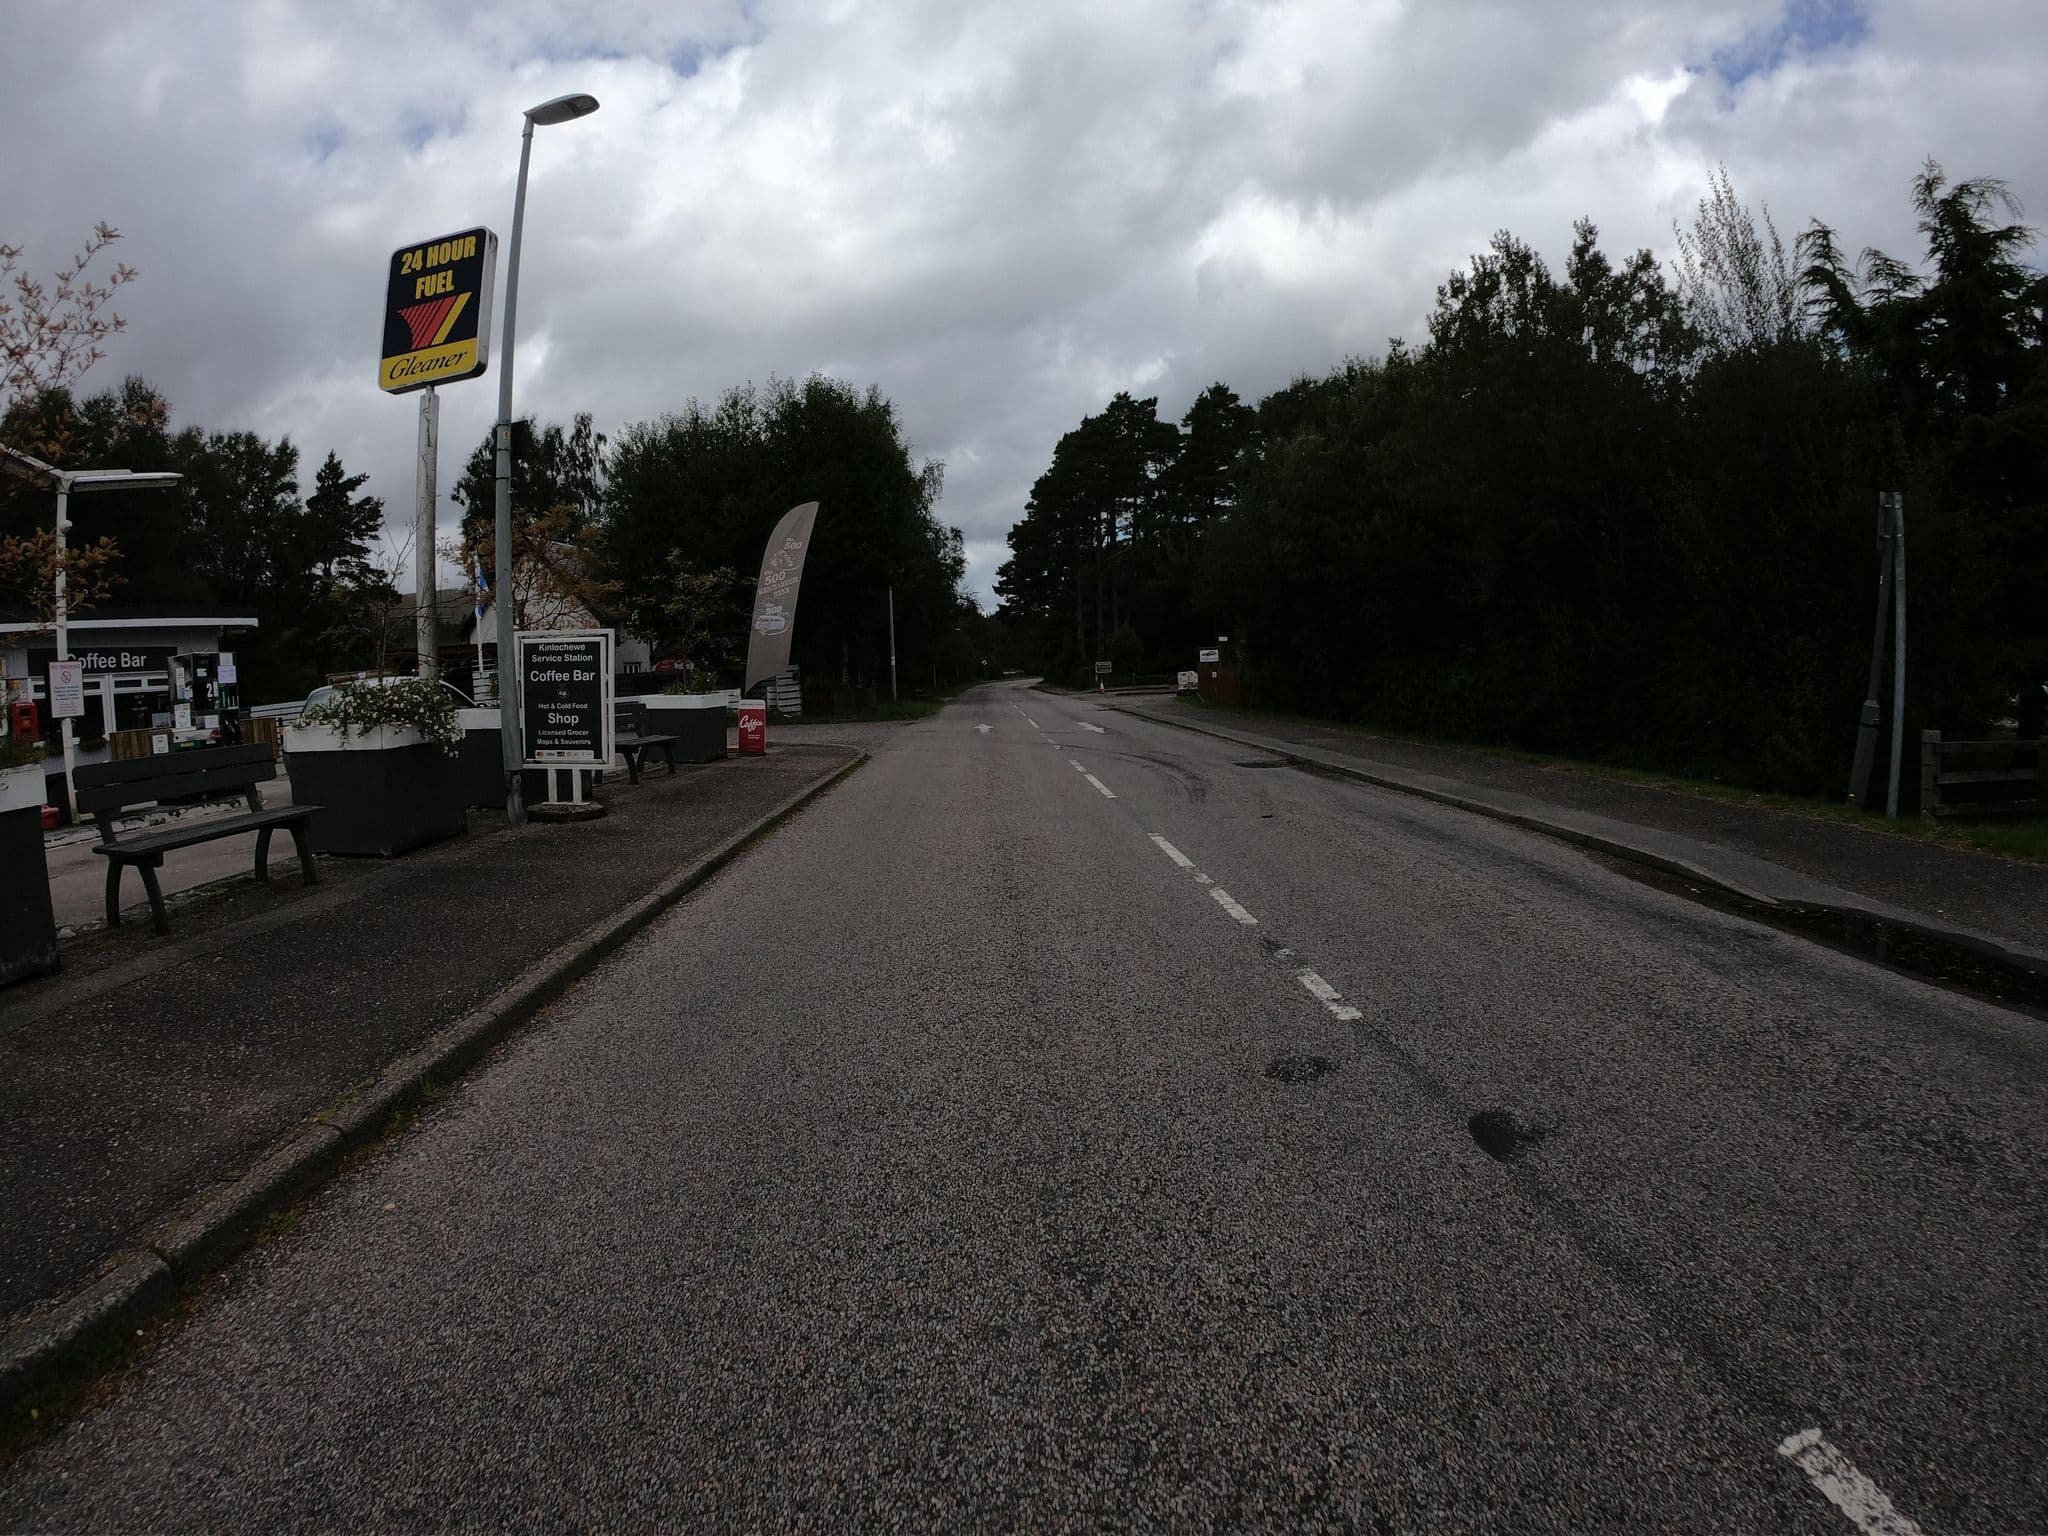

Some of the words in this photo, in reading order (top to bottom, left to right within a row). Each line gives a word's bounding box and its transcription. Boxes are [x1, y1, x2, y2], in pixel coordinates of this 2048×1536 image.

[400, 248, 423, 275] 24
[427, 236, 477, 268] HOUR
[415, 270, 454, 300] FUEL
[389, 350, 468, 380] Gleaner
[765, 571, 786, 586] 500
[765, 605, 783, 615] 500
[539, 643, 586, 651] Kinlochewe
[120, 651, 147, 668] Bar
[531, 654, 562, 663] Service
[564, 653, 593, 662] Station
[530, 670, 570, 682] Coffee
[573, 669, 596, 681] Bar
[548, 712, 579, 726] Shop
[537, 738, 553, 746] Maps
